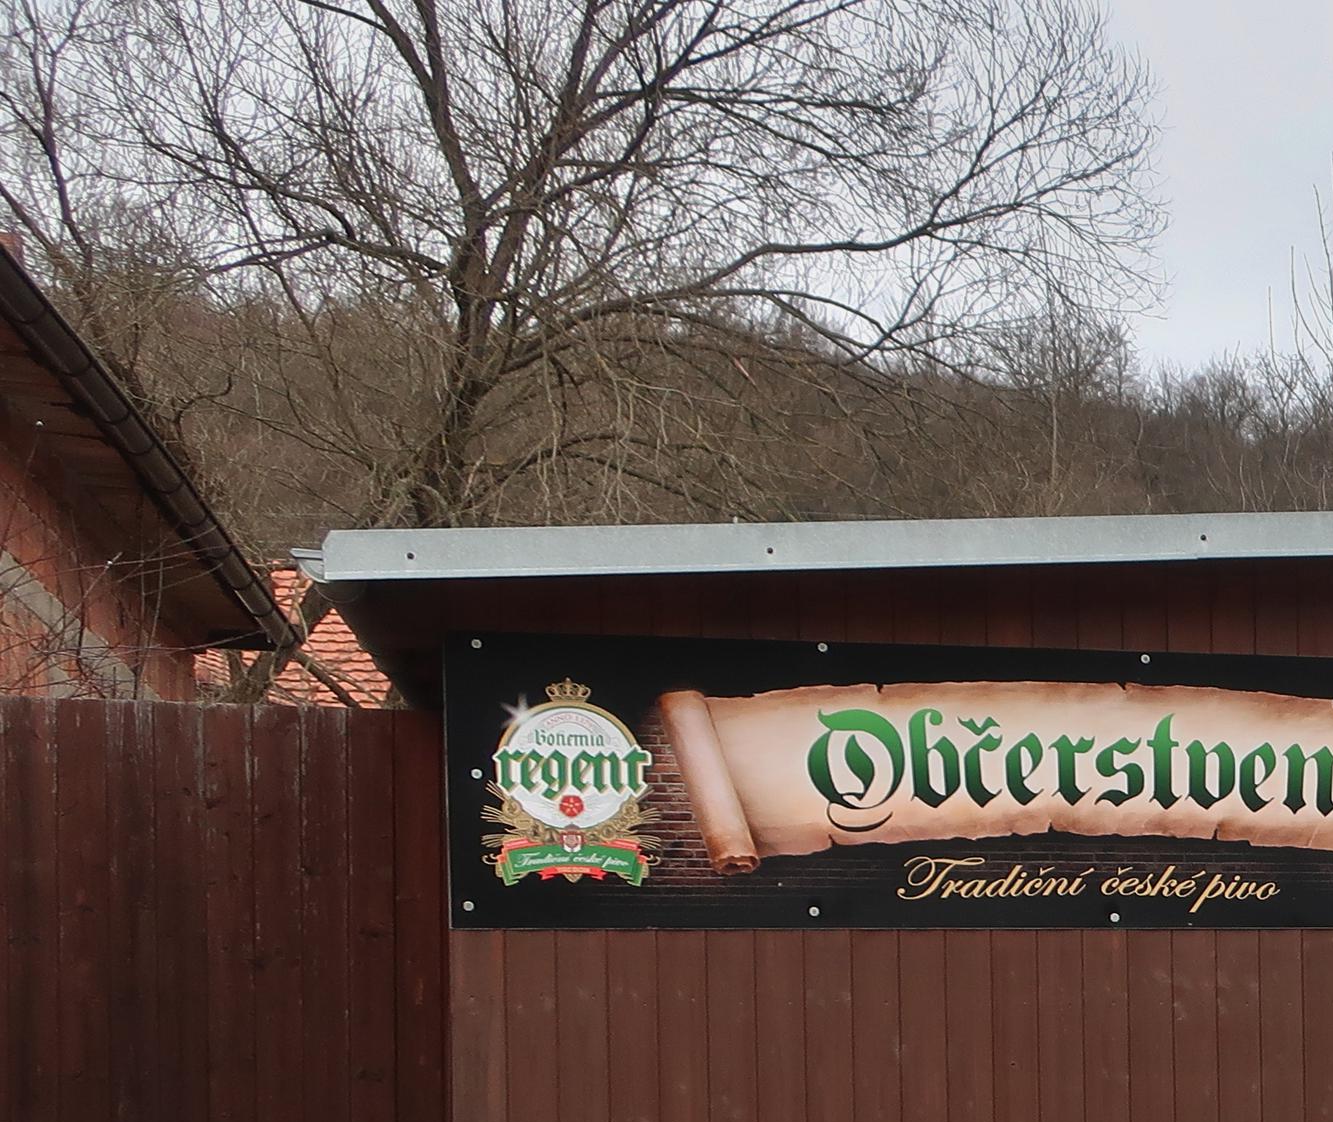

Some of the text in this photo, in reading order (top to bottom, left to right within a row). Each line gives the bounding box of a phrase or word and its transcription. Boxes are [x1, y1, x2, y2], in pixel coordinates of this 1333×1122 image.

[496, 748, 650, 800] regent
[897, 856, 1281, 912] Tradiční české pivo
